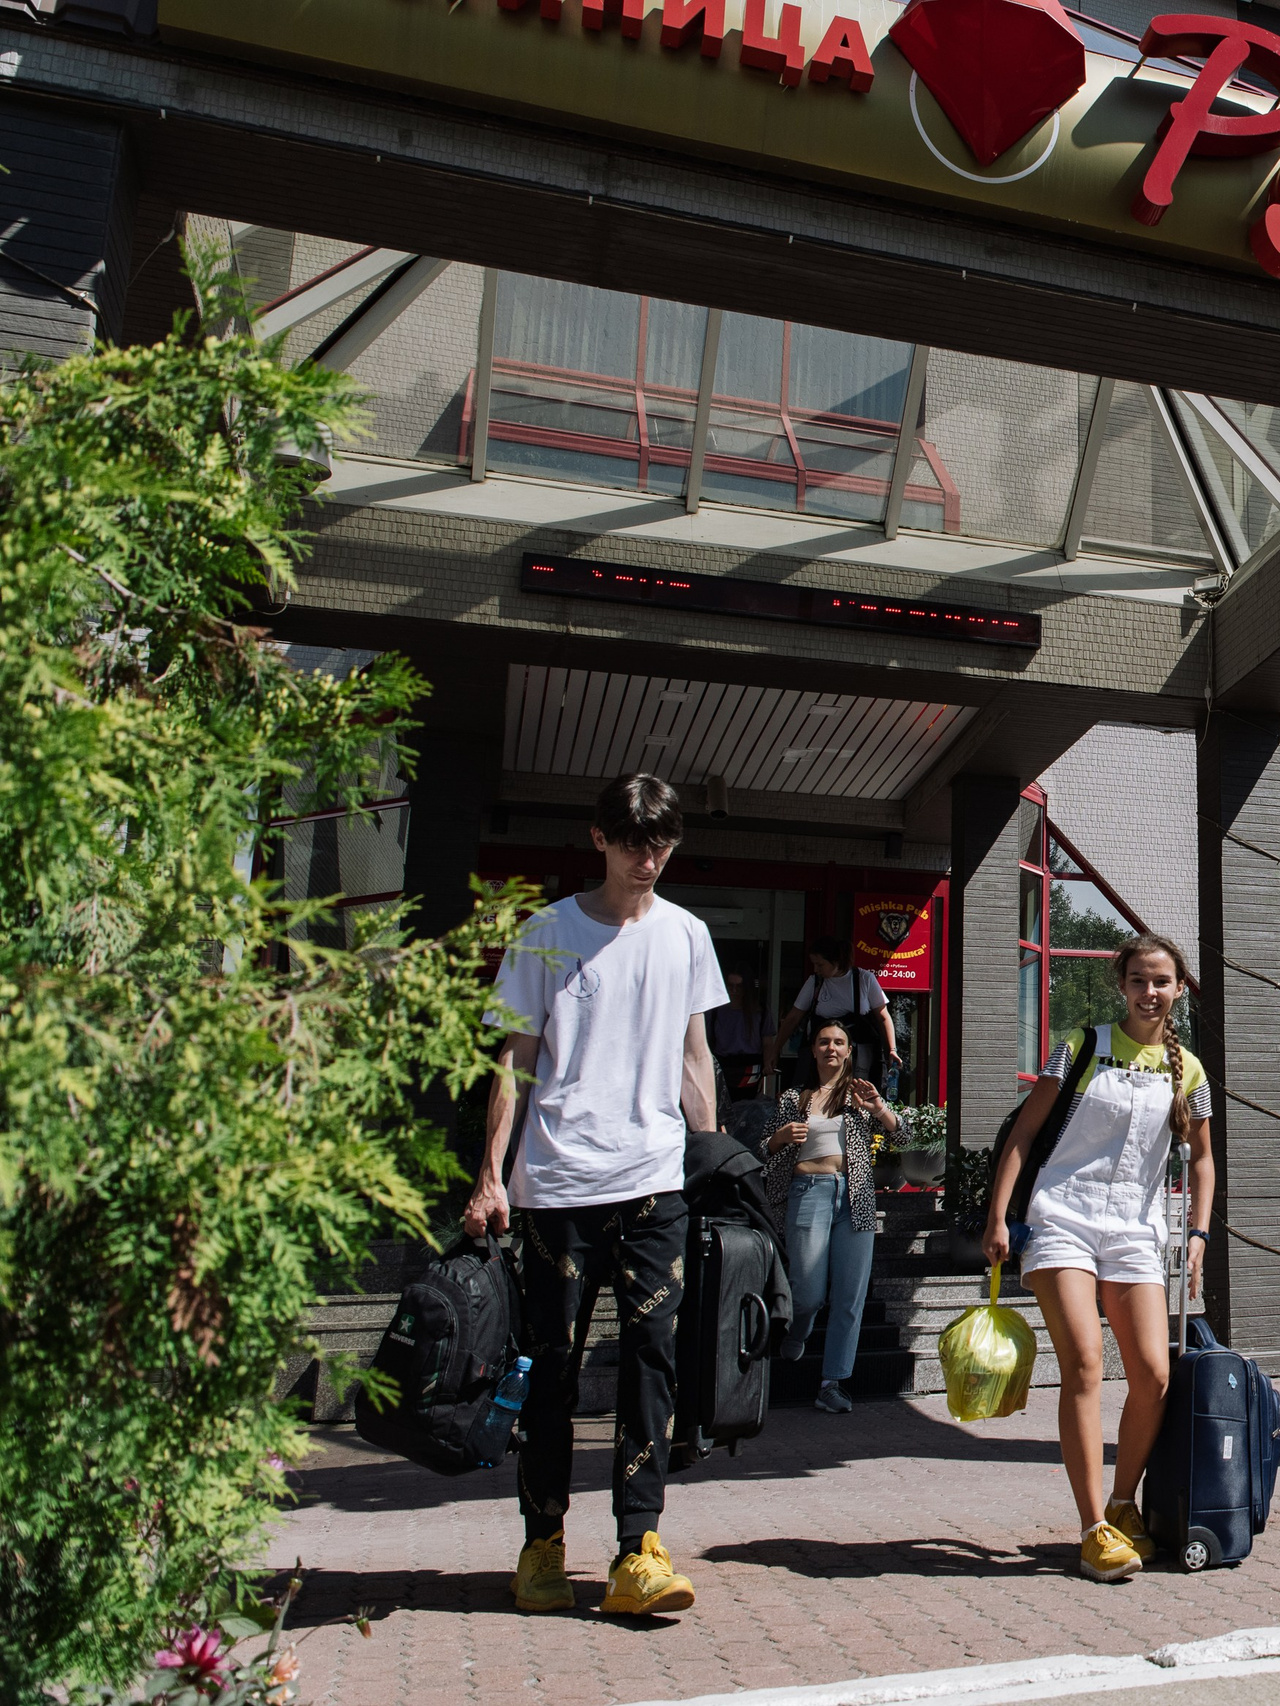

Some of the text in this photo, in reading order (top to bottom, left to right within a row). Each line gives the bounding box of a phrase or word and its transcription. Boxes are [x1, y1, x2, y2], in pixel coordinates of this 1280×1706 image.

[858, 901, 929, 920] Mishka Pub
[856, 940, 878, 956] Паб
